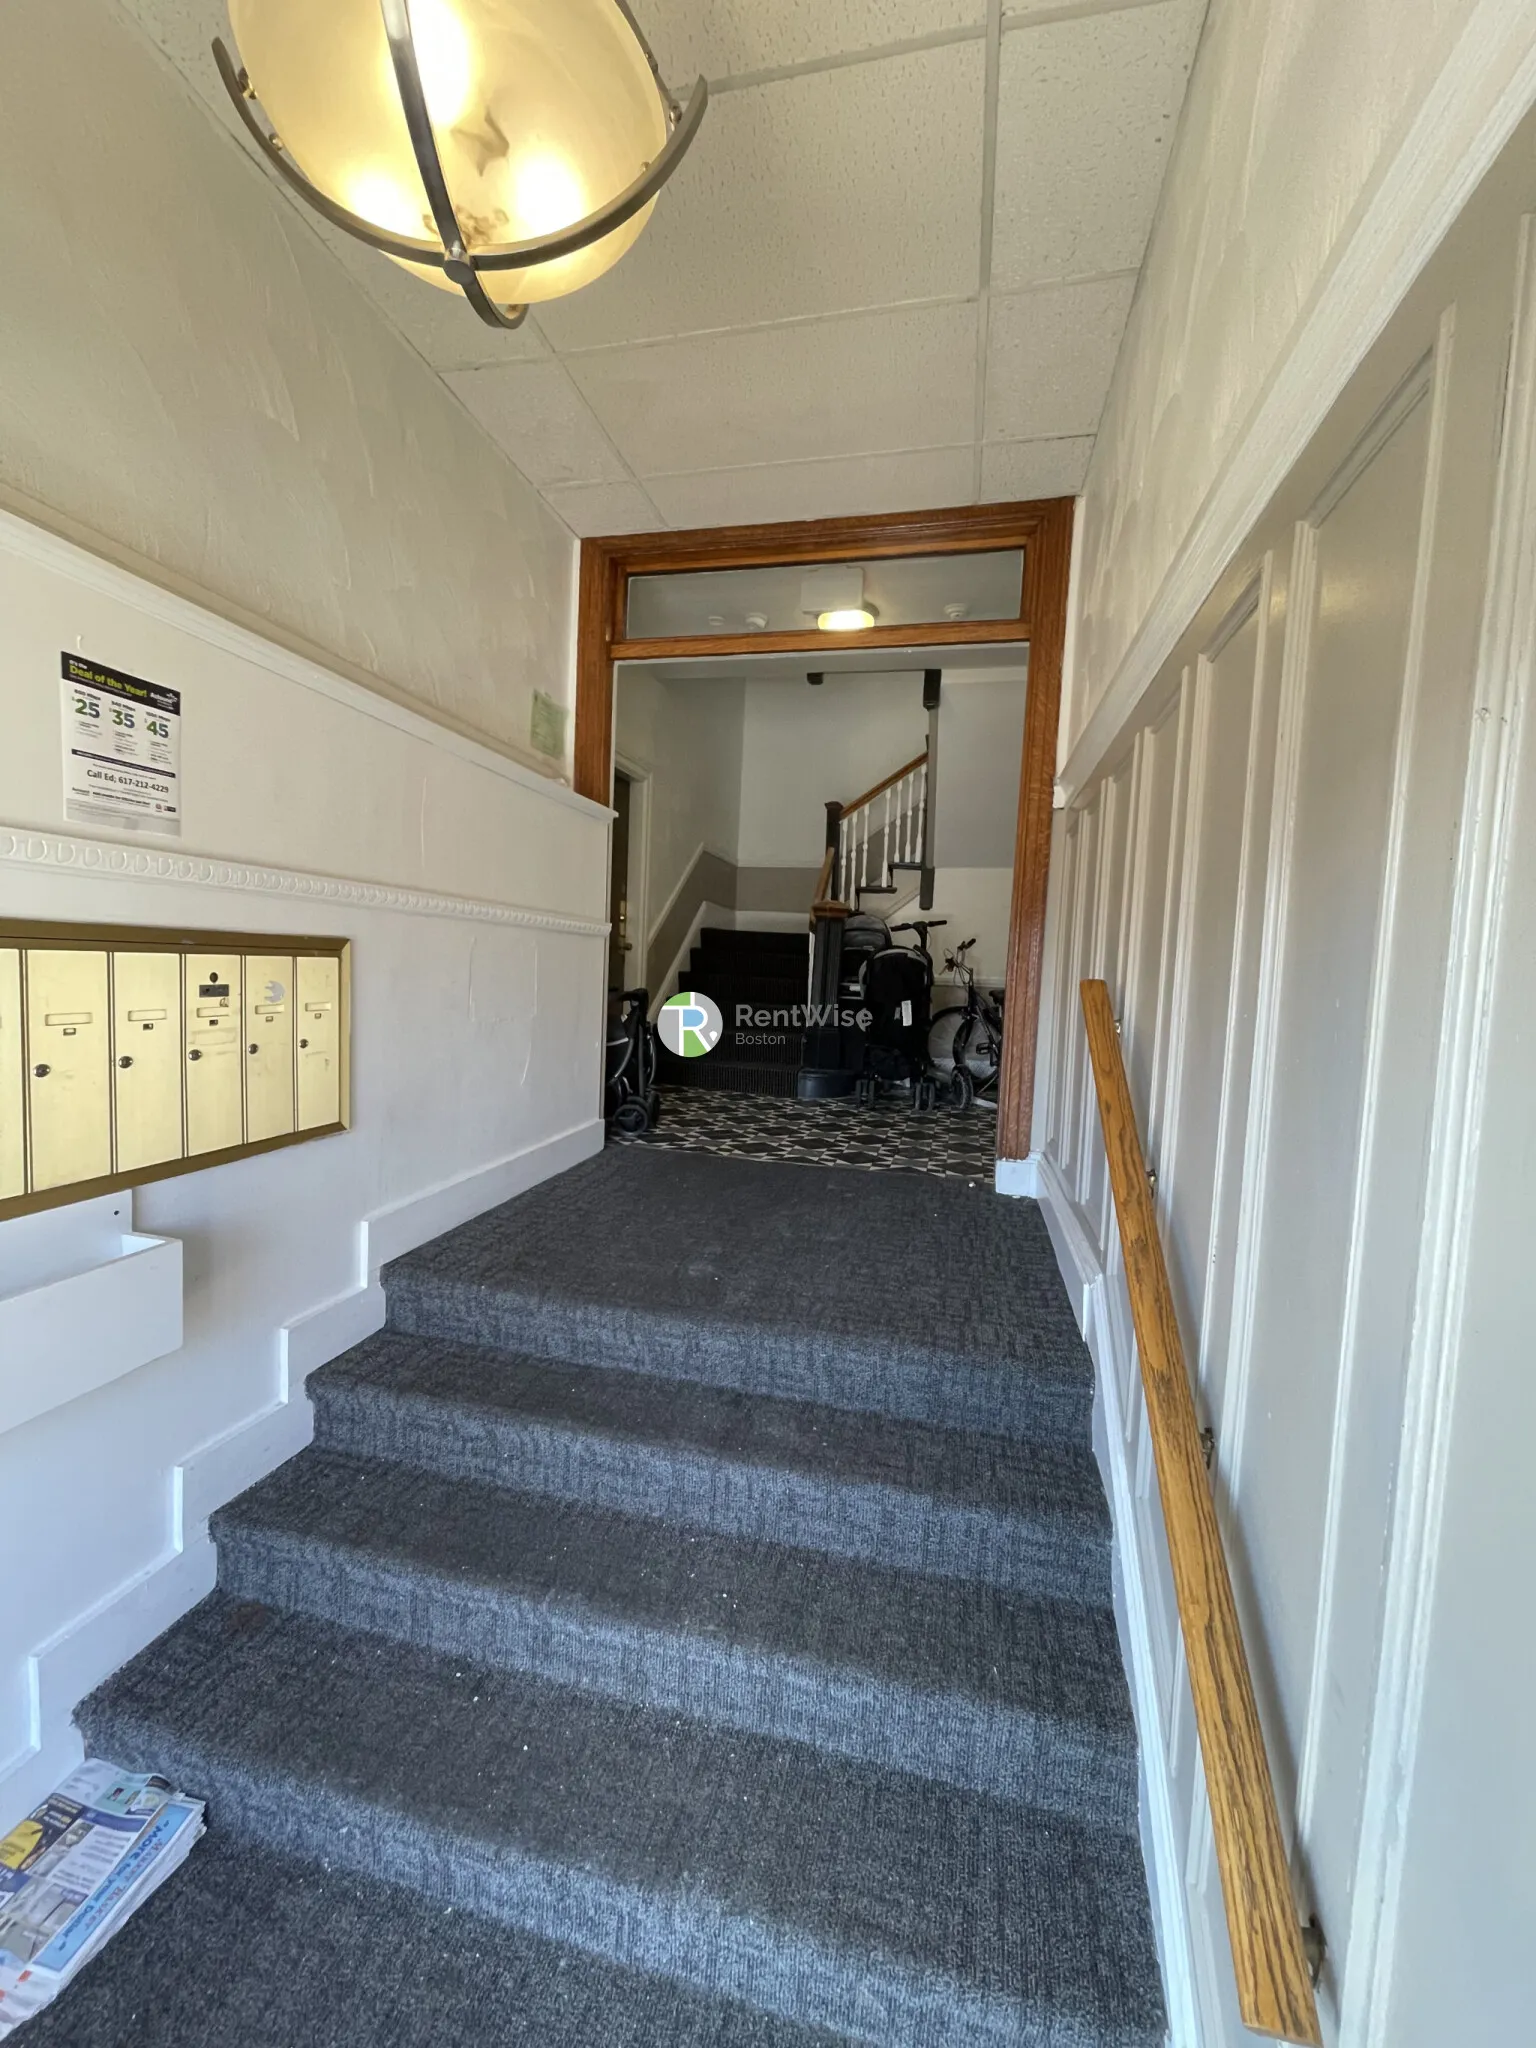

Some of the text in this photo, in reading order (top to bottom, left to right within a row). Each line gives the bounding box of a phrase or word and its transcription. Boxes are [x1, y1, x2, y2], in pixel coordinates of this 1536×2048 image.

[69, 664, 93, 680] Deal
[94, 674, 106, 684] of
[106, 677, 123, 690] the
[124, 683, 148, 698] Year!
[87, 769, 102, 779] Call
[118, 776, 169, 793] 617-212-4229
